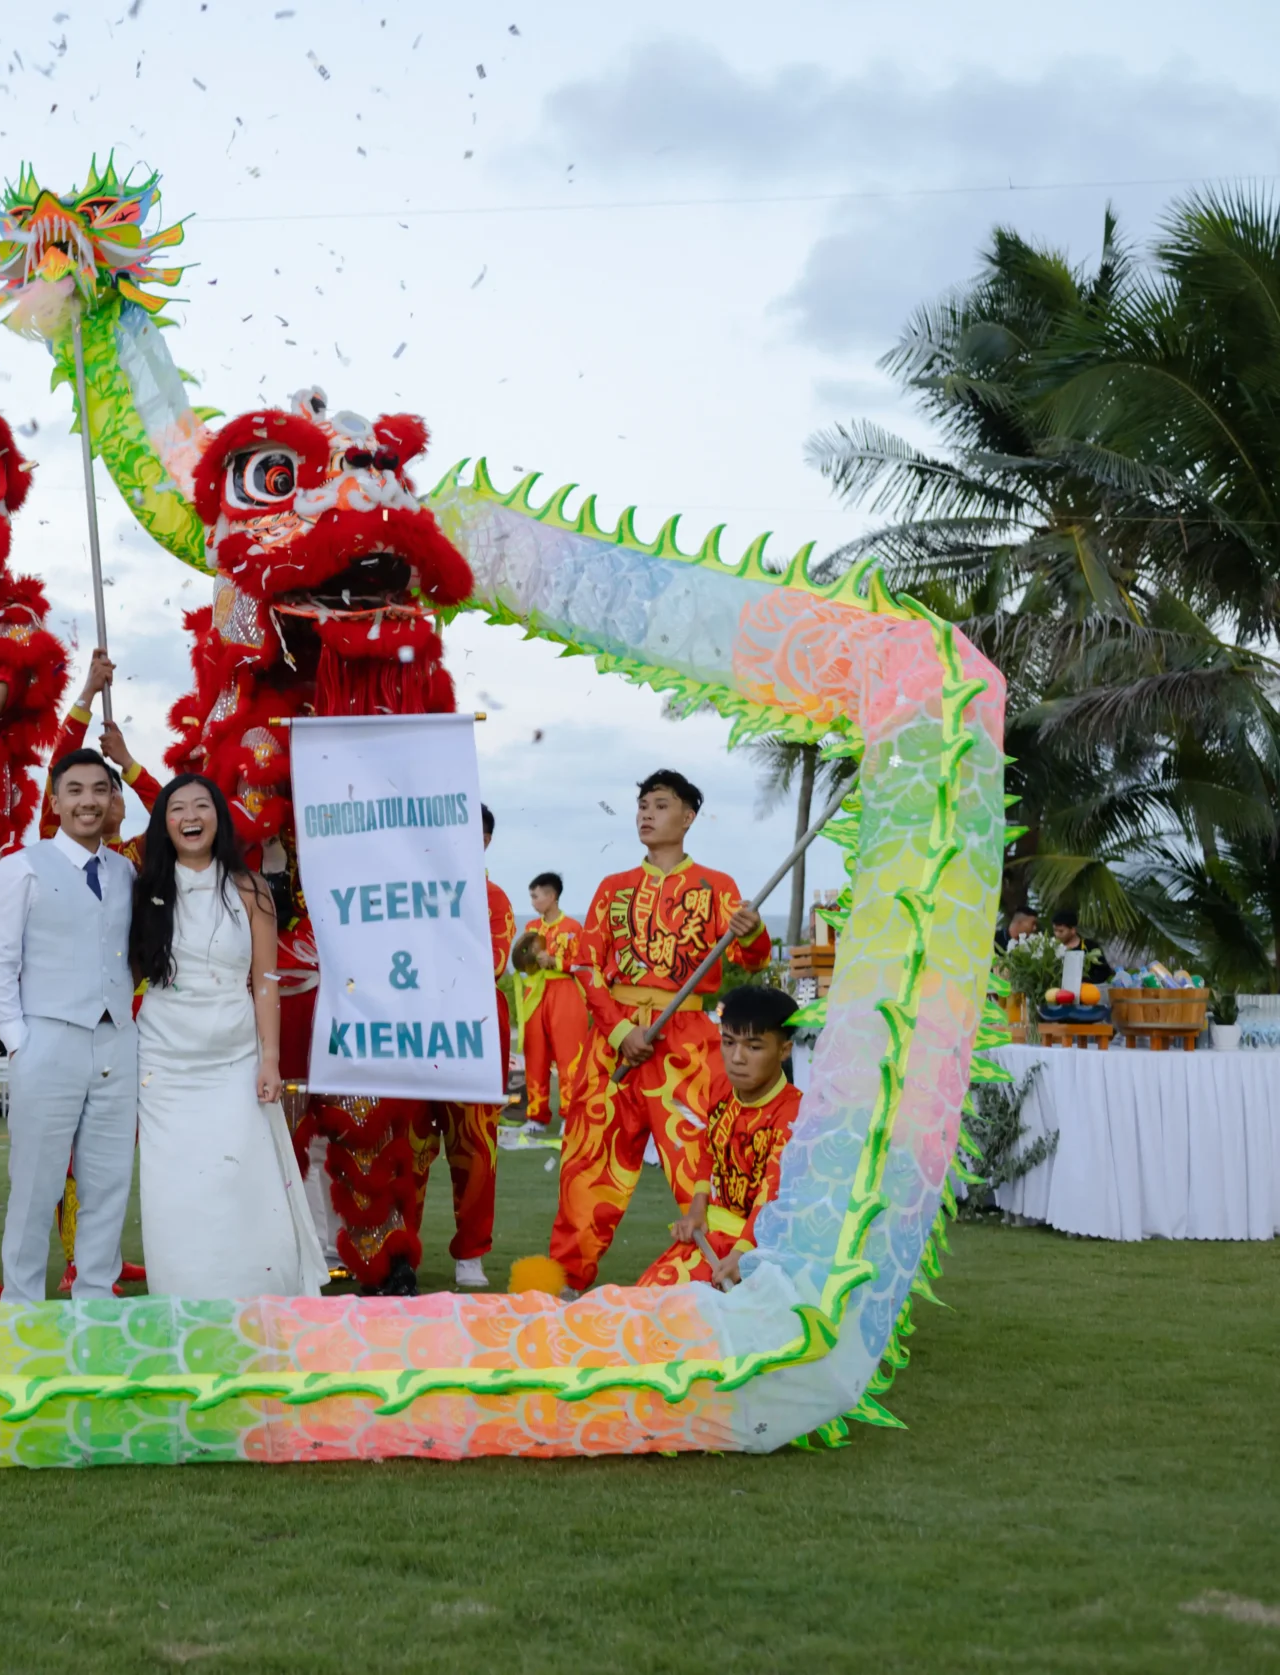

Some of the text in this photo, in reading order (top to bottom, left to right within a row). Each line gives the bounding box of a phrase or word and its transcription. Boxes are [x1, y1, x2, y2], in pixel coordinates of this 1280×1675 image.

[304, 792, 469, 838] CONGRATULATIONS
[330, 880, 467, 925] YEENY
[610, 888, 635, 940] VIET
[388, 950, 419, 989] &
[328, 1017, 483, 1058] KIENAN
